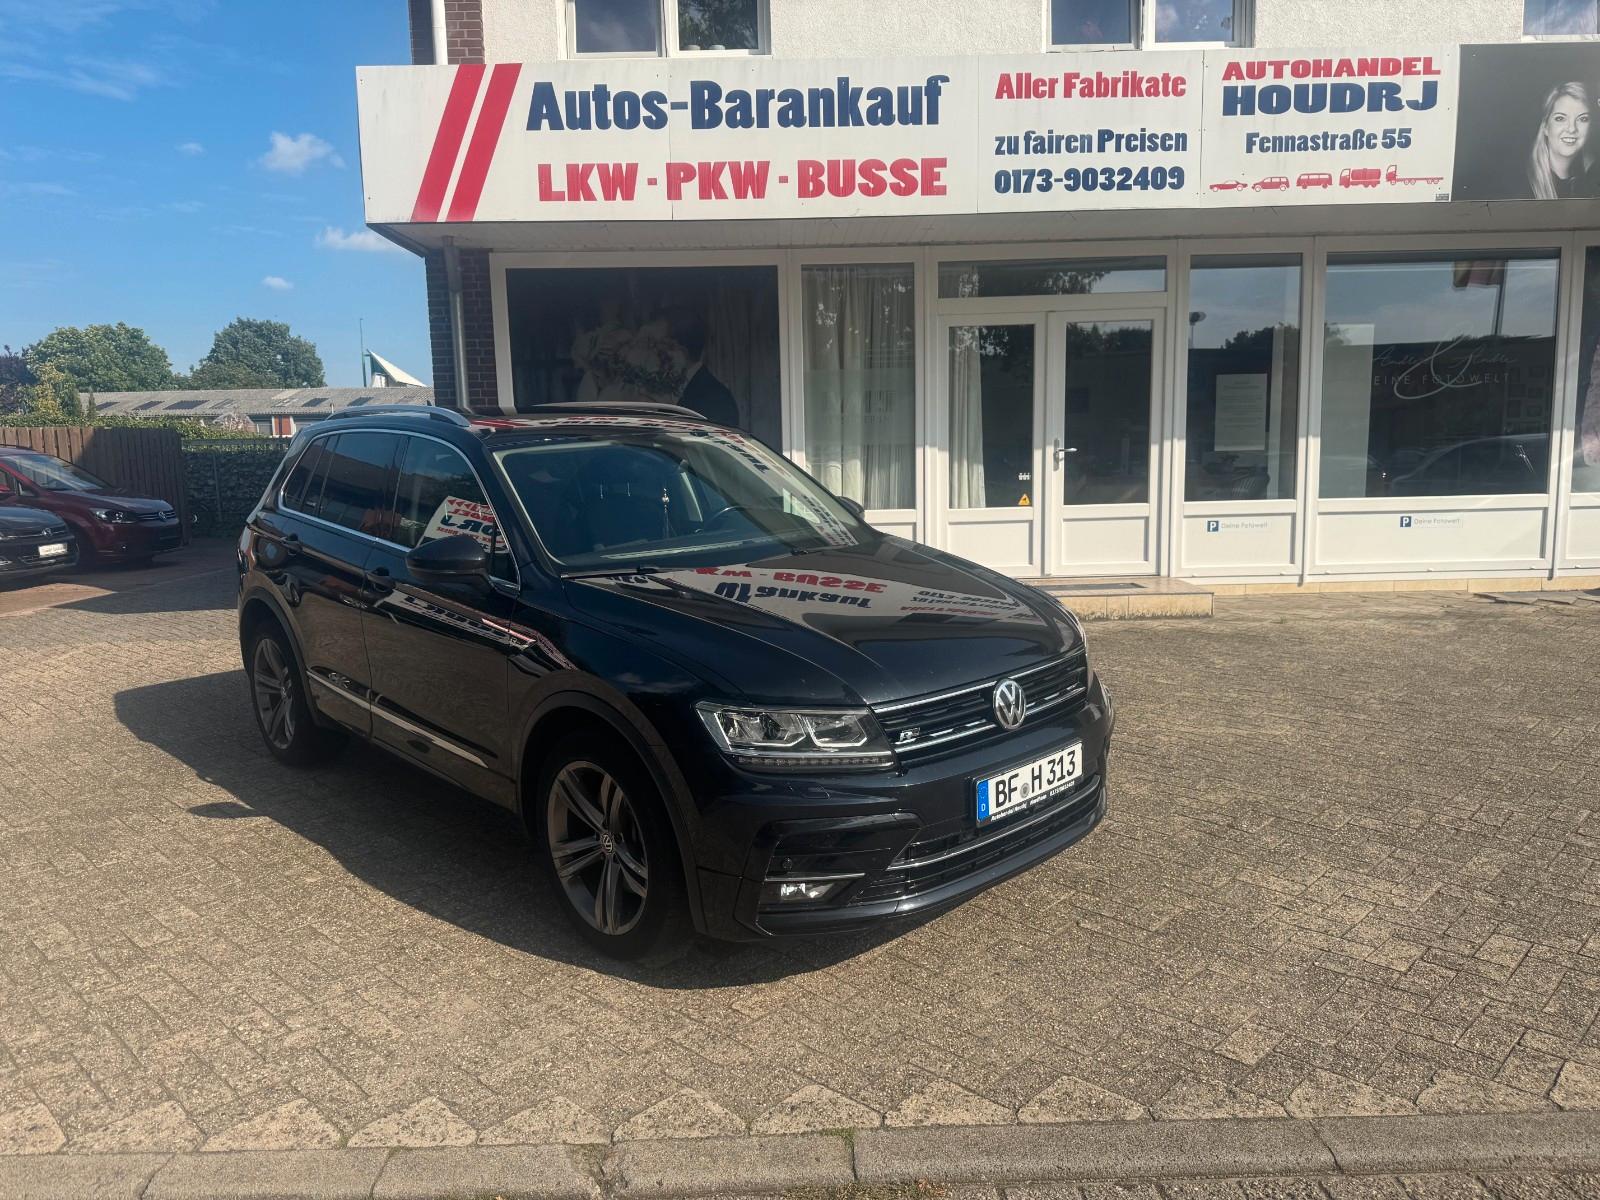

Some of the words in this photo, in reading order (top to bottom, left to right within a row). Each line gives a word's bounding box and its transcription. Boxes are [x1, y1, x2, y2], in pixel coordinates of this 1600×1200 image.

[1222, 56, 1441, 81] AUTOHANDEL
[995, 72, 1059, 99] Aller
[1063, 70, 1187, 98] Fabrikate
[1222, 81, 1438, 116] HOUDRJ
[526, 75, 949, 131] Autos-Barankauf
[994, 136, 1019, 155] zu
[1023, 129, 1092, 154] fairen
[1097, 127, 1188, 153] Preisen
[1245, 128, 1378, 154] Fennastraße
[1381, 127, 1412, 149] 55
[537, 162, 639, 202] LKW
[665, 160, 770, 201] PKW
[797, 157, 948, 199] BUSSE
[994, 165, 1185, 194] 0173-9032409
[995, 773, 1019, 809] BF
[1031, 764, 1043, 794] H
[1046, 749, 1076, 786] 313
